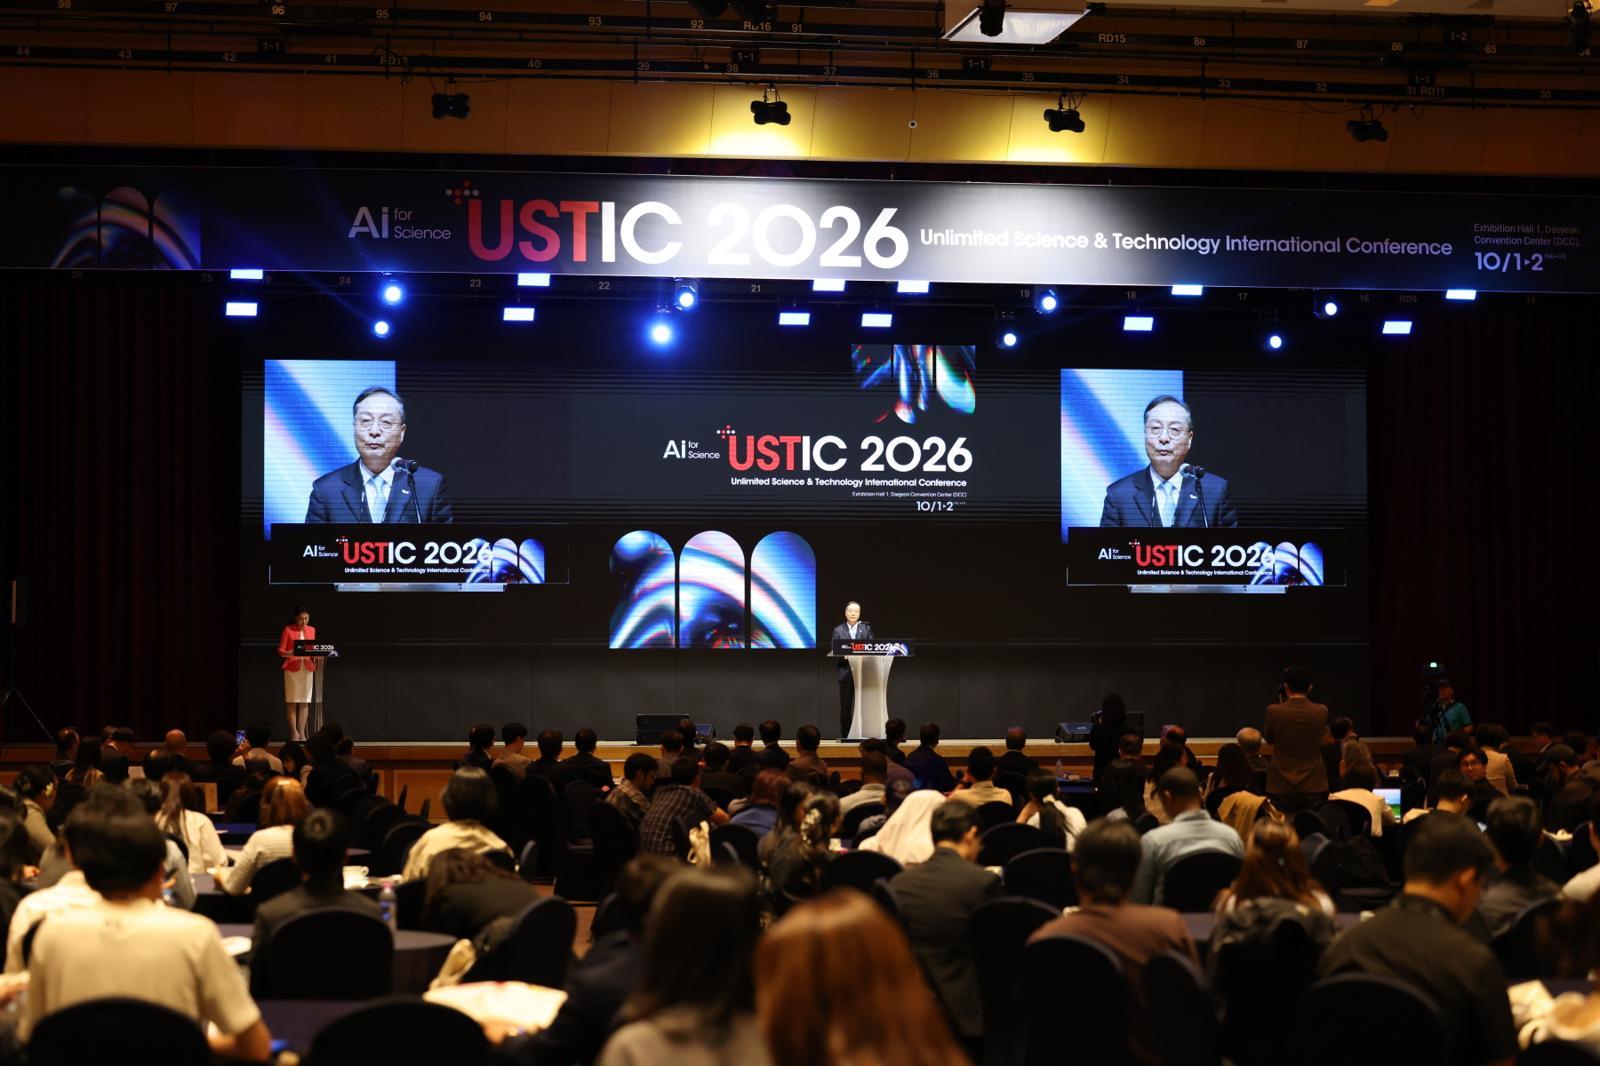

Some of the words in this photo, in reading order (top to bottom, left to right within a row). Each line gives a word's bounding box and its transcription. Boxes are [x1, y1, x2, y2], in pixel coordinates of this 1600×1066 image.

[164, 2, 177, 12] 97
[272, 5, 285, 15] 96
[376, 9, 389, 19] 95
[479, 12, 492, 22] 94
[588, 16, 602, 26] 93
[691, 19, 704, 29] 92
[791, 23, 802, 32] 91
[1098, 33, 1126, 43] RD15
[262, 41, 280, 51] 1-1
[1296, 40, 1308, 48] 87
[16, 47, 31, 56] 44
[118, 49, 132, 59] 43
[737, 52, 755, 61] 1-1
[222, 52, 237, 62] 42
[324, 55, 337, 64] 41
[527, 59, 541, 69] 40
[637, 61, 650, 71] 39
[726, 63, 739, 72] 38
[823, 66, 837, 75] 37
[926, 70, 939, 79] 36
[1021, 72, 1035, 81] 35
[1219, 79, 1232, 88] 33
[1315, 82, 1328, 91] 32
[394, 208, 413, 221] for
[393, 225, 451, 240] Science
[1474, 224, 1516, 233] Exhibition
[1518, 224, 1534, 233] Hall
[467, 199, 683, 265] USTIC
[706, 202, 909, 269] 2026
[920, 228, 1009, 247] Unlimited
[1013, 230, 1089, 250] Science
[1094, 232, 1108, 250] &
[1112, 232, 1221, 255] Technology
[1226, 233, 1341, 254] International
[1346, 236, 1453, 256] Conference
[1474, 236, 1522, 245] Convention
[470, 278, 482, 288] 23
[598, 281, 610, 290] 22
[751, 283, 761, 293] 21
[1239, 292, 1248, 302] 17
[688, 440, 698, 449] for
[688, 450, 720, 460] Science
[728, 435, 847, 472] USTIC
[860, 435, 974, 473] 2026
[731, 477, 770, 486] Unlimited
[771, 477, 805, 486] Science
[806, 478, 814, 486] &
[814, 478, 863, 488] Technology
[865, 479, 917, 487] International
[918, 479, 967, 487] Conference
[343, 541, 417, 565] USTIC
[424, 541, 492, 565] 2026
[1135, 545, 1204, 567] USTIC
[1211, 545, 1274, 567] 2026
